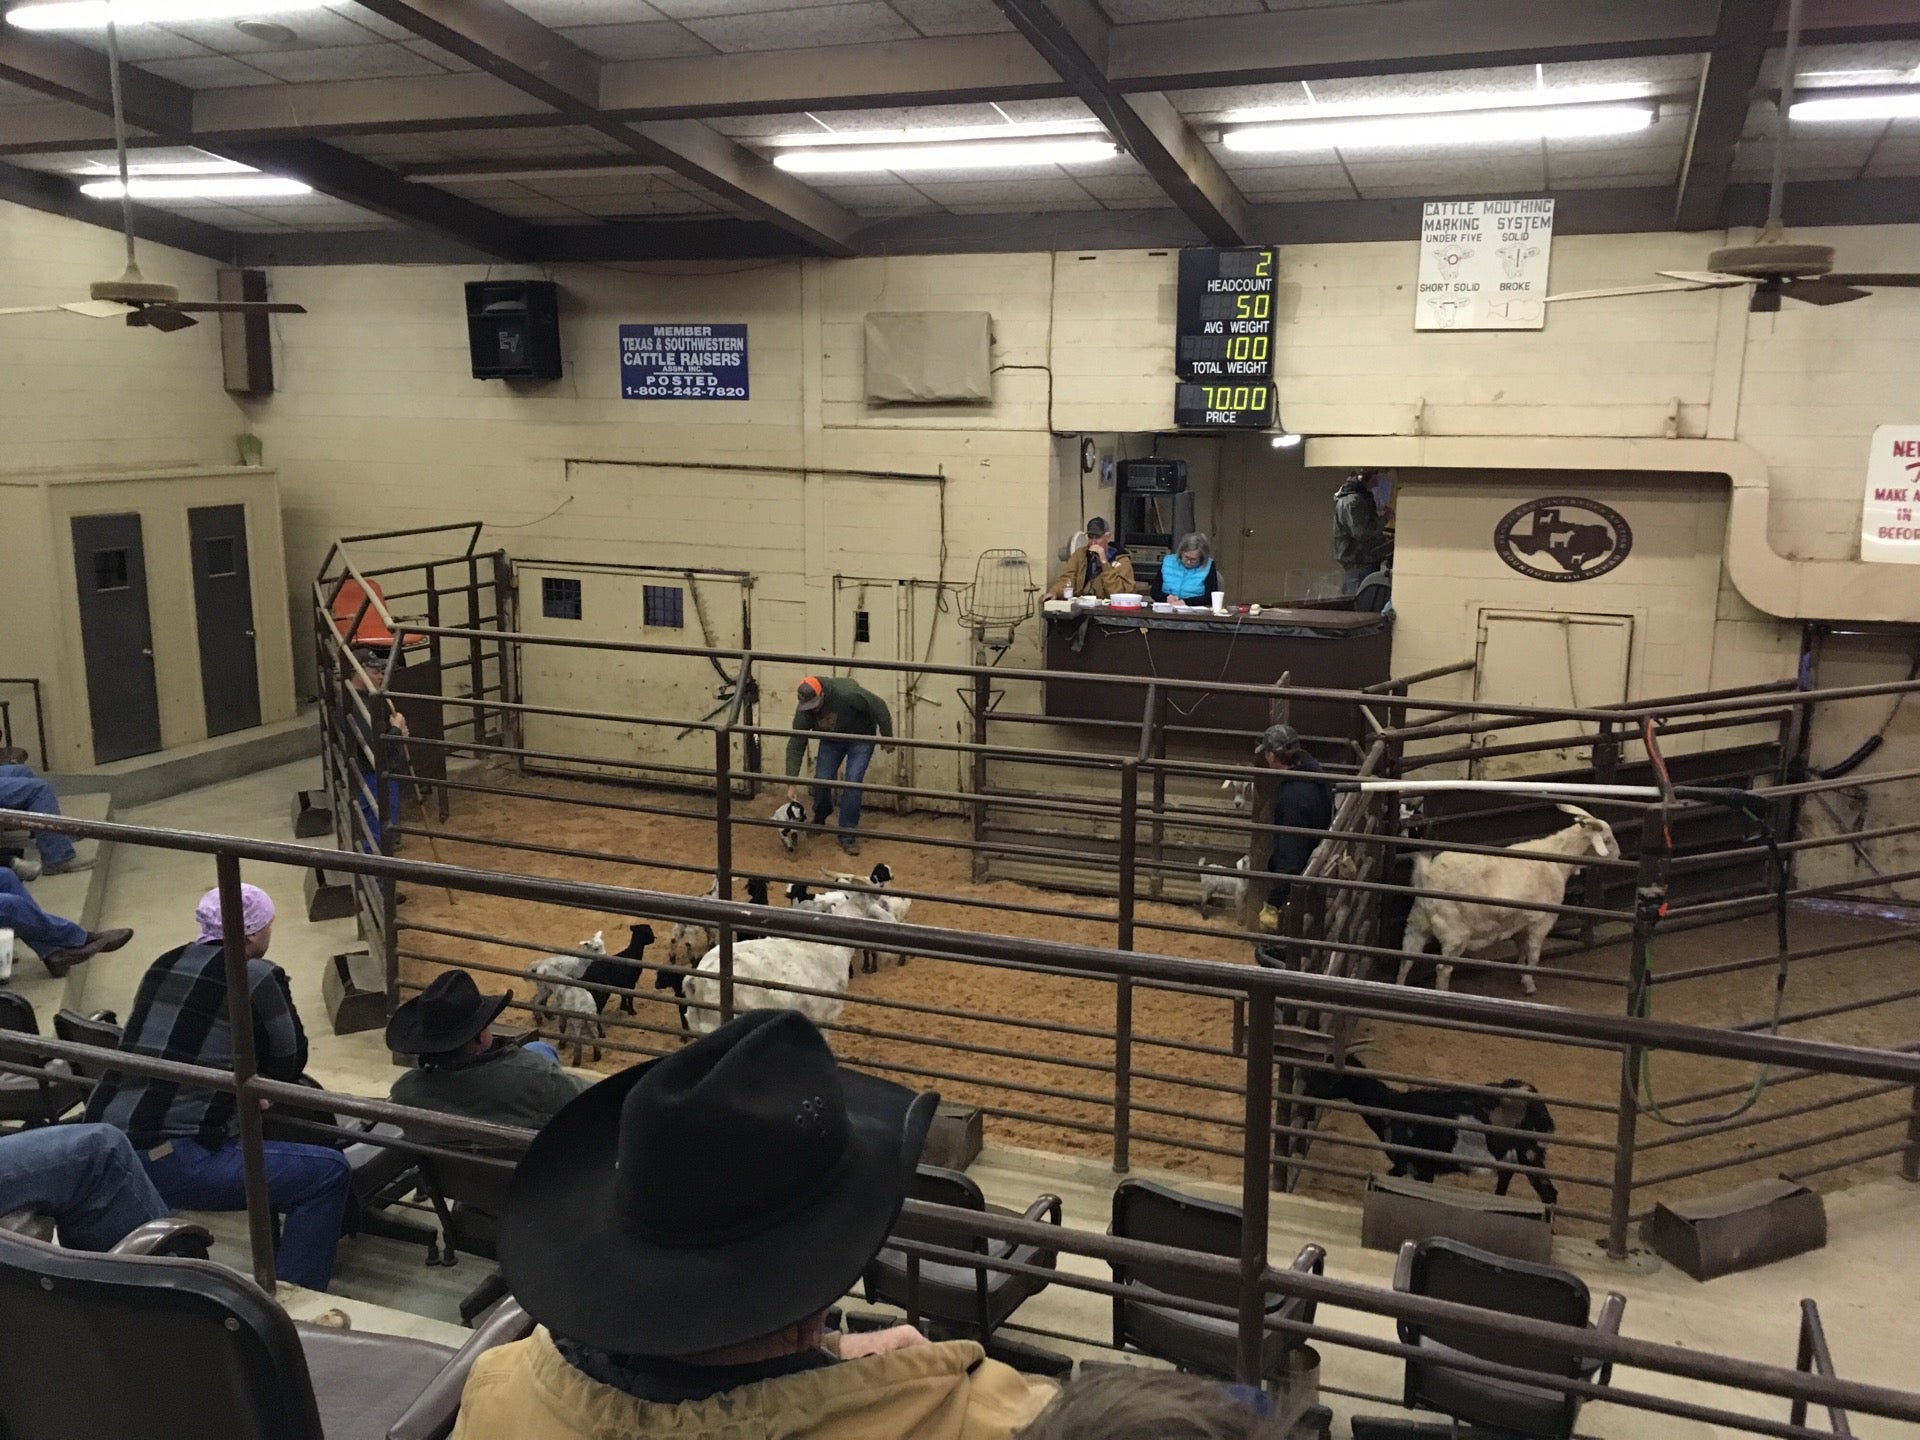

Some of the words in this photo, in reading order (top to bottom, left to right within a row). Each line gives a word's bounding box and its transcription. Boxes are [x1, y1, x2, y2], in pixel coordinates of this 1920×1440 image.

[1425, 203, 1475, 216] CATTLE
[1483, 200, 1552, 215] MOUTHING
[1424, 218, 1480, 231] MARKING
[1497, 216, 1551, 230] SYSTEM
[1426, 233, 1457, 243] UNDER
[1460, 233, 1482, 242] FIVE
[1502, 232, 1529, 242] SOLID
[1255, 252, 1272, 276] 2
[1207, 278, 1272, 292] HEADCOUNT
[1419, 283, 1449, 292] SHORT
[1453, 283, 1480, 292] SOLID
[1499, 282, 1531, 291] BROKE
[1236, 294, 1269, 319] 50
[654, 326, 712, 336] MEMBER
[1204, 321, 1223, 334] AVG
[1230, 320, 1269, 334] WEIGHT
[623, 337, 653, 351] TEXAS
[655, 338, 663, 351] &
[664, 337, 744, 351] SOUTHWESTERN
[1226, 336, 1268, 360] 100
[623, 353, 675, 366] CATTLE
[680, 352, 741, 366] RAISERS
[1192, 361, 1222, 374] TOTAL
[1226, 361, 1267, 374] WEIGHT
[646, 376, 718, 386] POSTED
[626, 386, 745, 396] 1-800-242-7820
[1206, 411, 1237, 423] PRICE
[1875, 488, 1908, 502] MAKE
